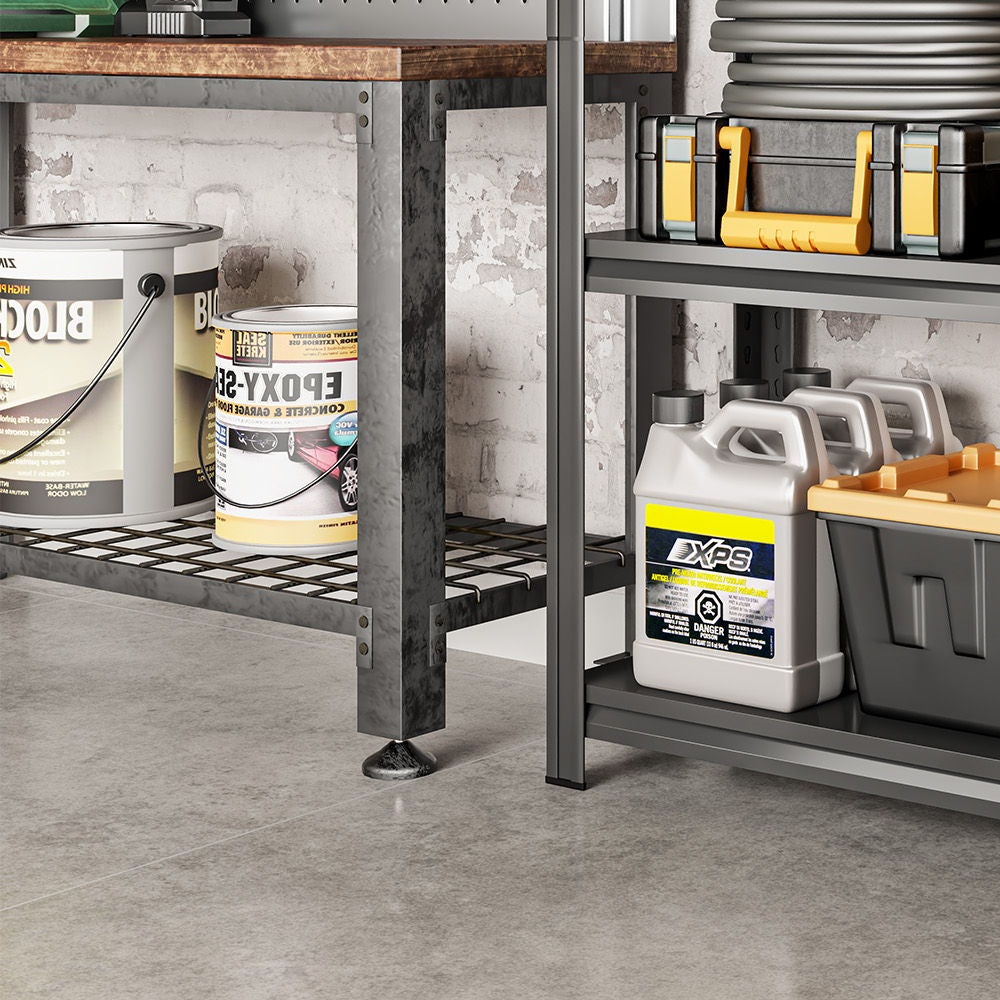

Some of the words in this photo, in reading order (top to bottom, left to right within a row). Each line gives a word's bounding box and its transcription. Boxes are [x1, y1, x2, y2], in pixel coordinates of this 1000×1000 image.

[684, 537, 753, 572] XPS
[693, 622, 725, 637] DANGER
[699, 632, 718, 641] POISON
